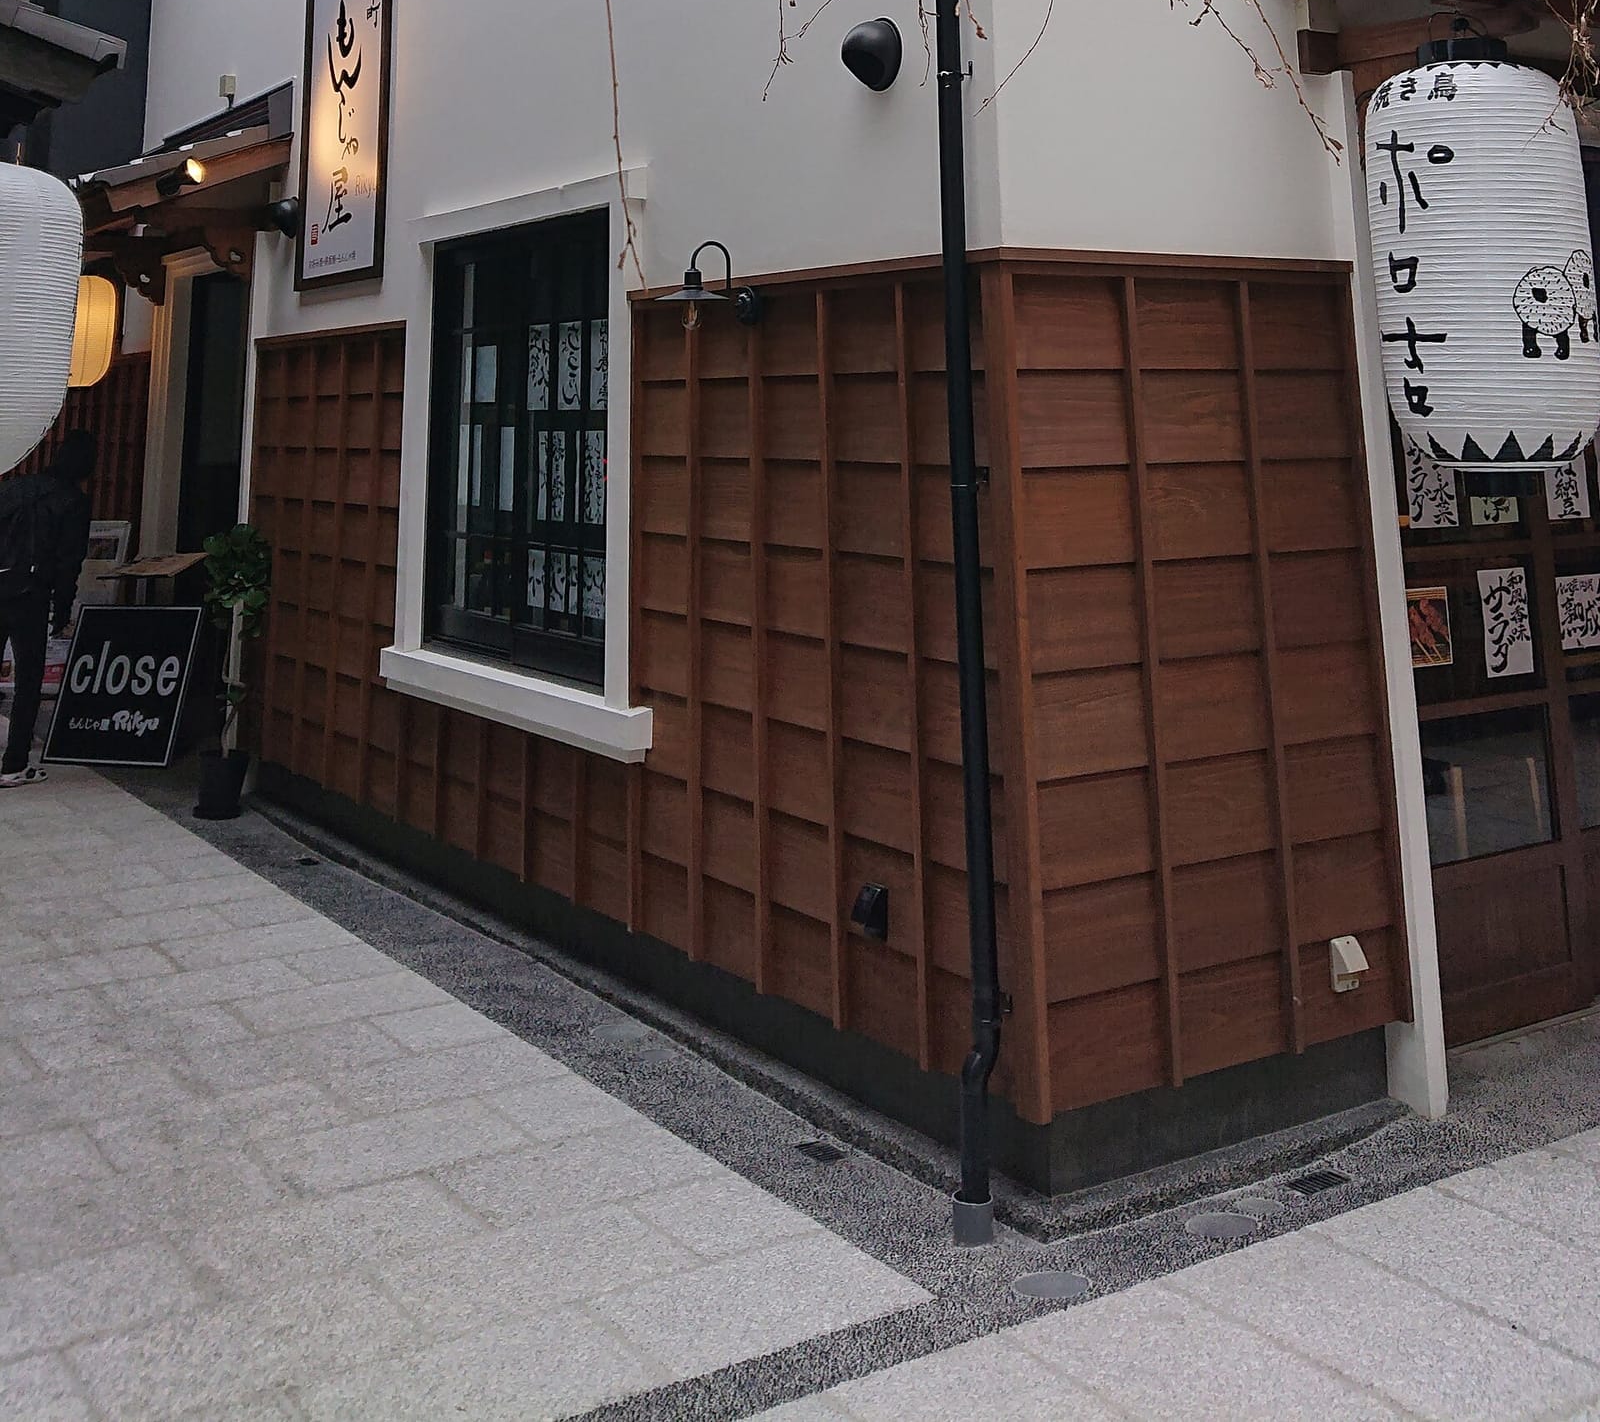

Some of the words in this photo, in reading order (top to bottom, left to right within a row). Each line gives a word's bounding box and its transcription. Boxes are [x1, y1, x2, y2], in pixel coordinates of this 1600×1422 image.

[1372, 72, 1458, 114] 焼き鳥
[355, 175, 376, 199] Riky
[1483, 576, 1517, 673] サラダ
[70, 640, 180, 697] close
[112, 710, 159, 737] Rikyu
